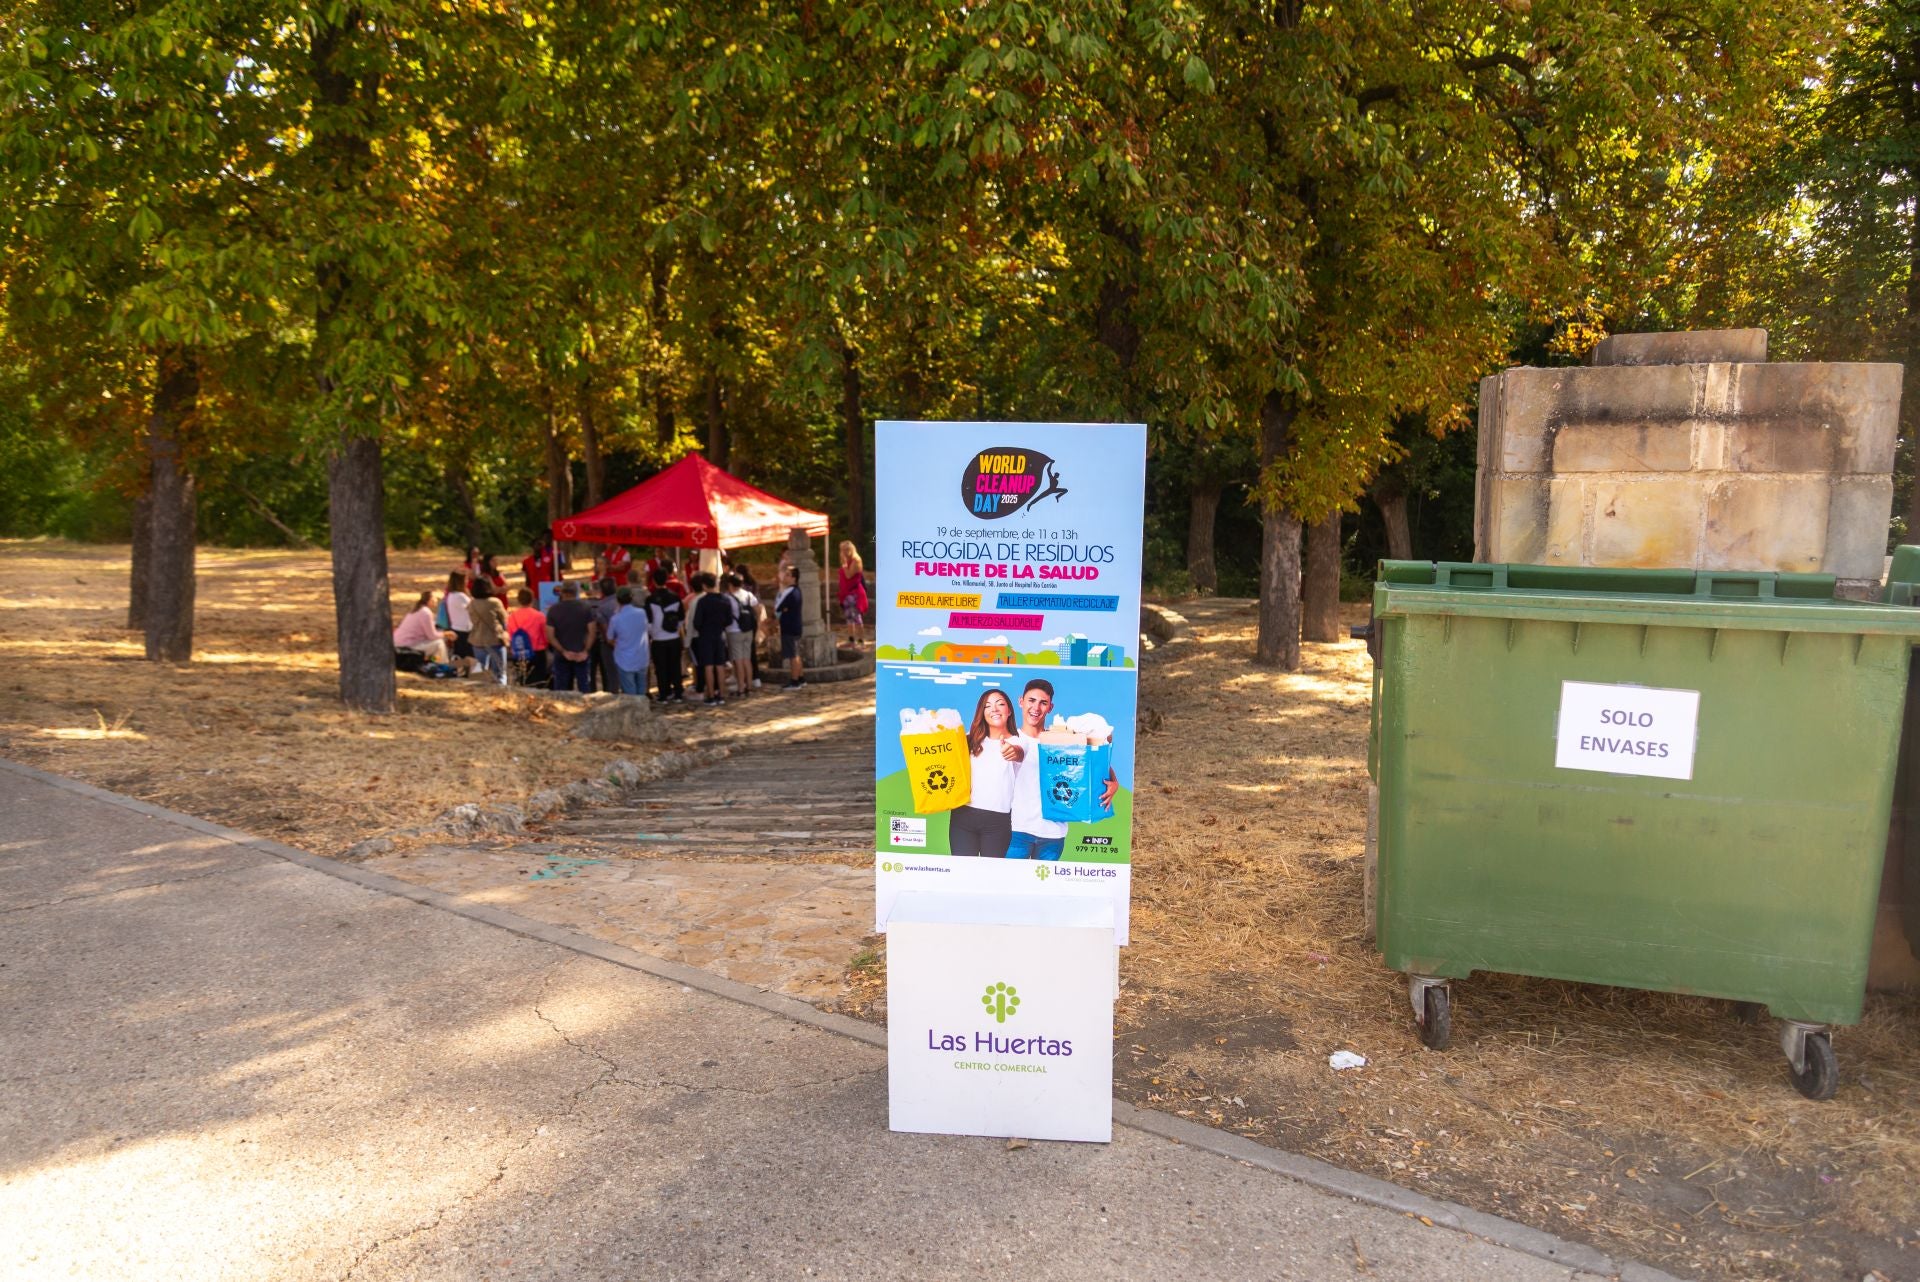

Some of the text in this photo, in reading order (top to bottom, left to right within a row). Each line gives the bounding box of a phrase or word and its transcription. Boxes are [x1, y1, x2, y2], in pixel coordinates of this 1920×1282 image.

[980, 454, 1026, 474] WORLD
[975, 474, 1035, 494] CLEANUP
[973, 493, 1019, 513] DAY 2025
[937, 526, 1079, 540] 19 de septiembre, de 11 a 13h
[997, 542, 1021, 562] DE
[915, 561, 1099, 581] FUENTE DE LA SALUD
[899, 594, 979, 608] PASEO AL AIRE LIBRE
[1000, 596, 1116, 609] TALLER FORMATIVO RECICLAJE
[952, 615, 1041, 628] ALMUERZO SALUDABLE
[1600, 709, 1653, 728] SOLO
[914, 742, 953, 756] PLASTIC
[1580, 735, 1669, 758] ENVASES
[1047, 756, 1079, 766] PAPER
[1092, 837, 1109, 845] INFO
[1075, 845, 1088, 853] 979
[1054, 865, 1117, 878] Las Huertas
[928, 1029, 1073, 1056] Las Huertas
[954, 1061, 1048, 1074] CENTRO COMERCIAL
